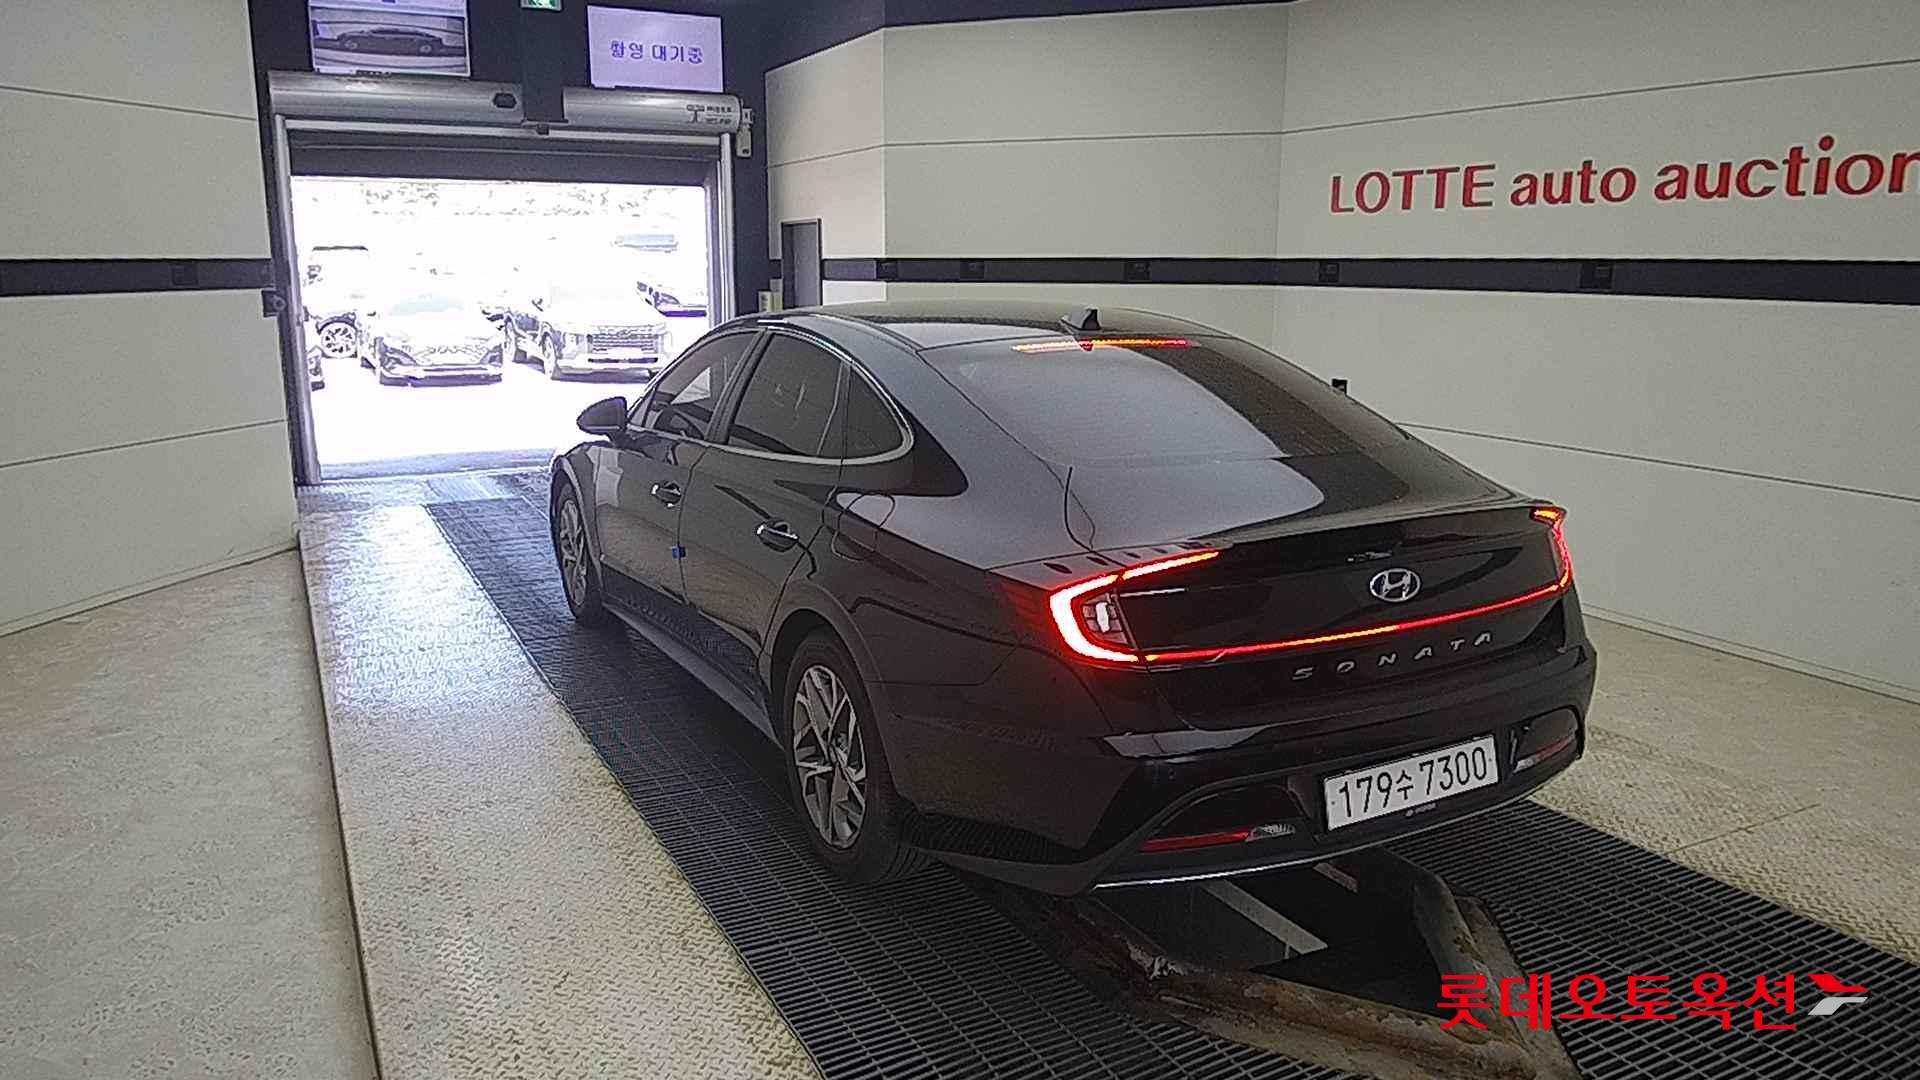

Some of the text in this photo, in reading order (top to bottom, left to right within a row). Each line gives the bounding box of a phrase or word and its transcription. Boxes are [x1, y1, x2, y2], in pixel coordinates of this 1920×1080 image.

[652, 44, 703, 64] 대기중
[1330, 164, 1496, 213] LOTTE
[1510, 159, 1637, 206] auto
[1292, 632, 1491, 681] SONATA
